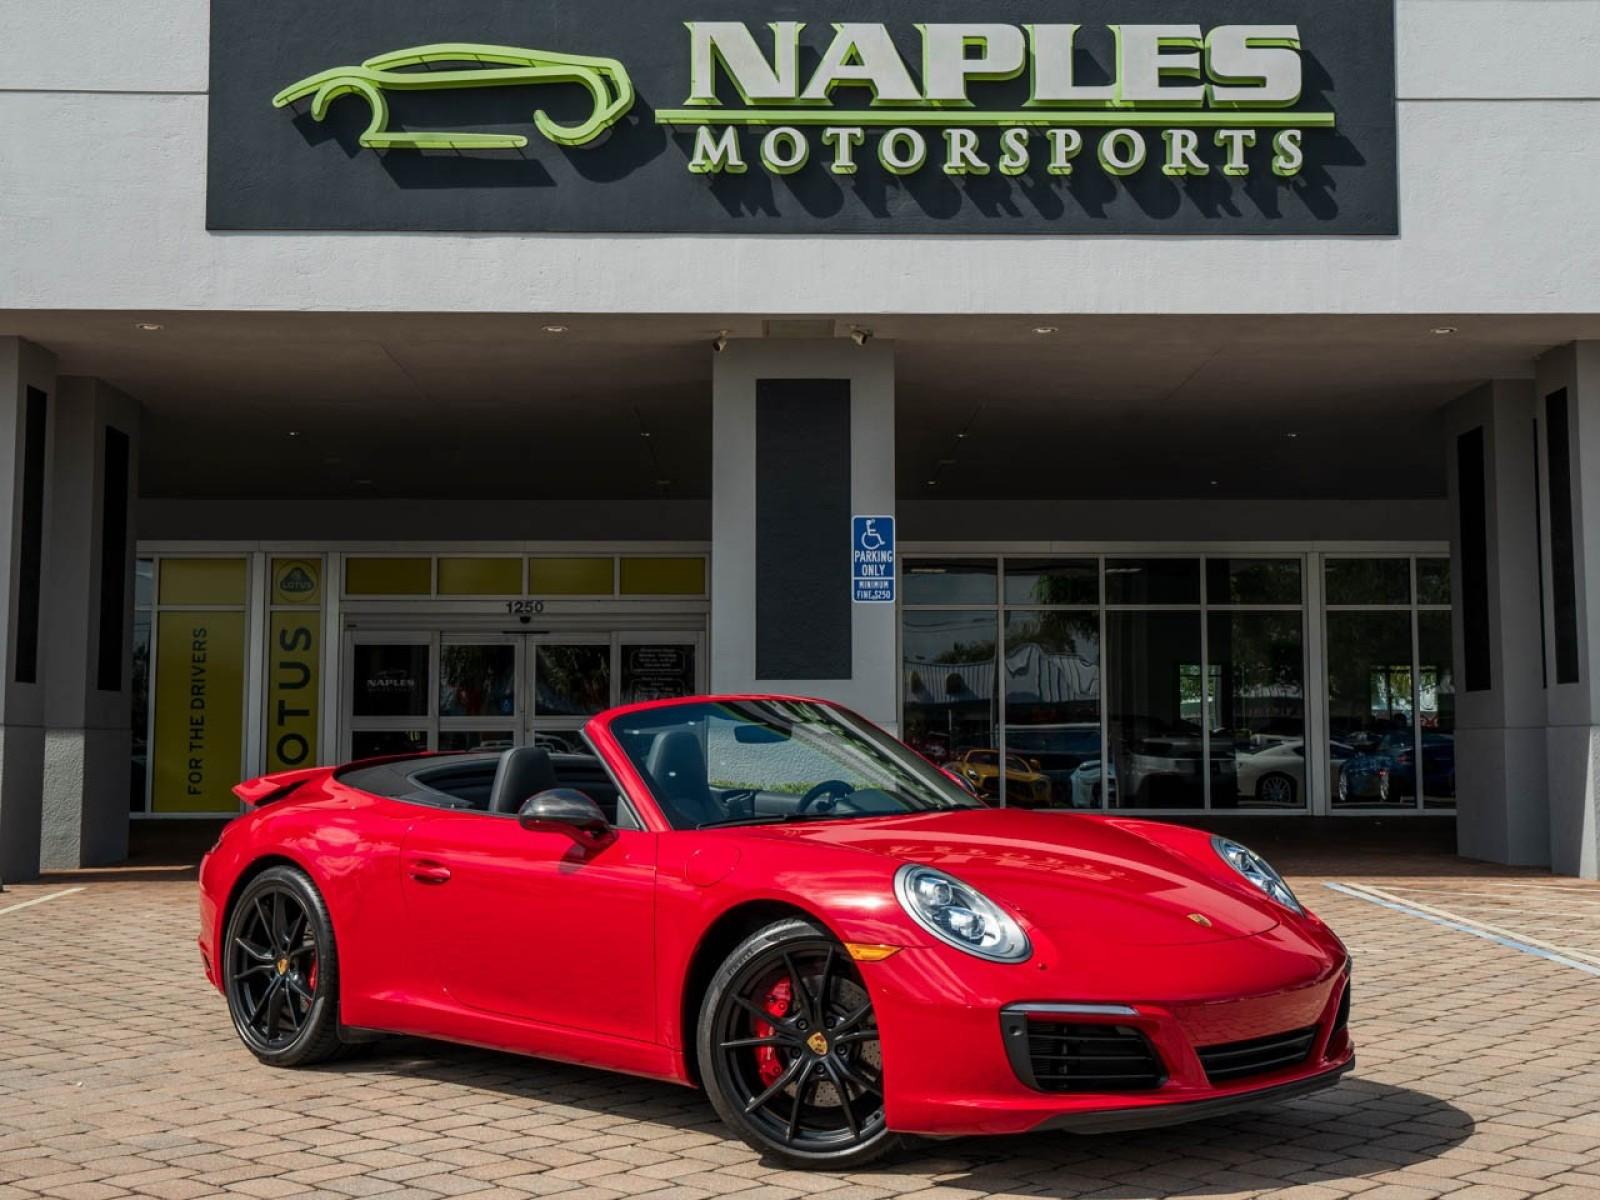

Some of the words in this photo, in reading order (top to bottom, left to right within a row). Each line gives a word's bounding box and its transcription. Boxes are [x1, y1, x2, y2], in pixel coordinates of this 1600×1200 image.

[683, 20, 1303, 109] NAPLES
[687, 124, 1305, 177] MOTORSPORTS
[854, 550, 892, 562] PARKING
[862, 564, 885, 576] ONLY
[856, 590, 872, 600] FINE
[859, 581, 889, 589] MINIMUM
[506, 602, 544, 614] 1250
[191, 627, 208, 711] DRIVERS
[367, 679, 415, 687] NAPLES
[276, 627, 312, 766] OTUS
[189, 715, 205, 752] THE
[188, 759, 203, 795] FOR
